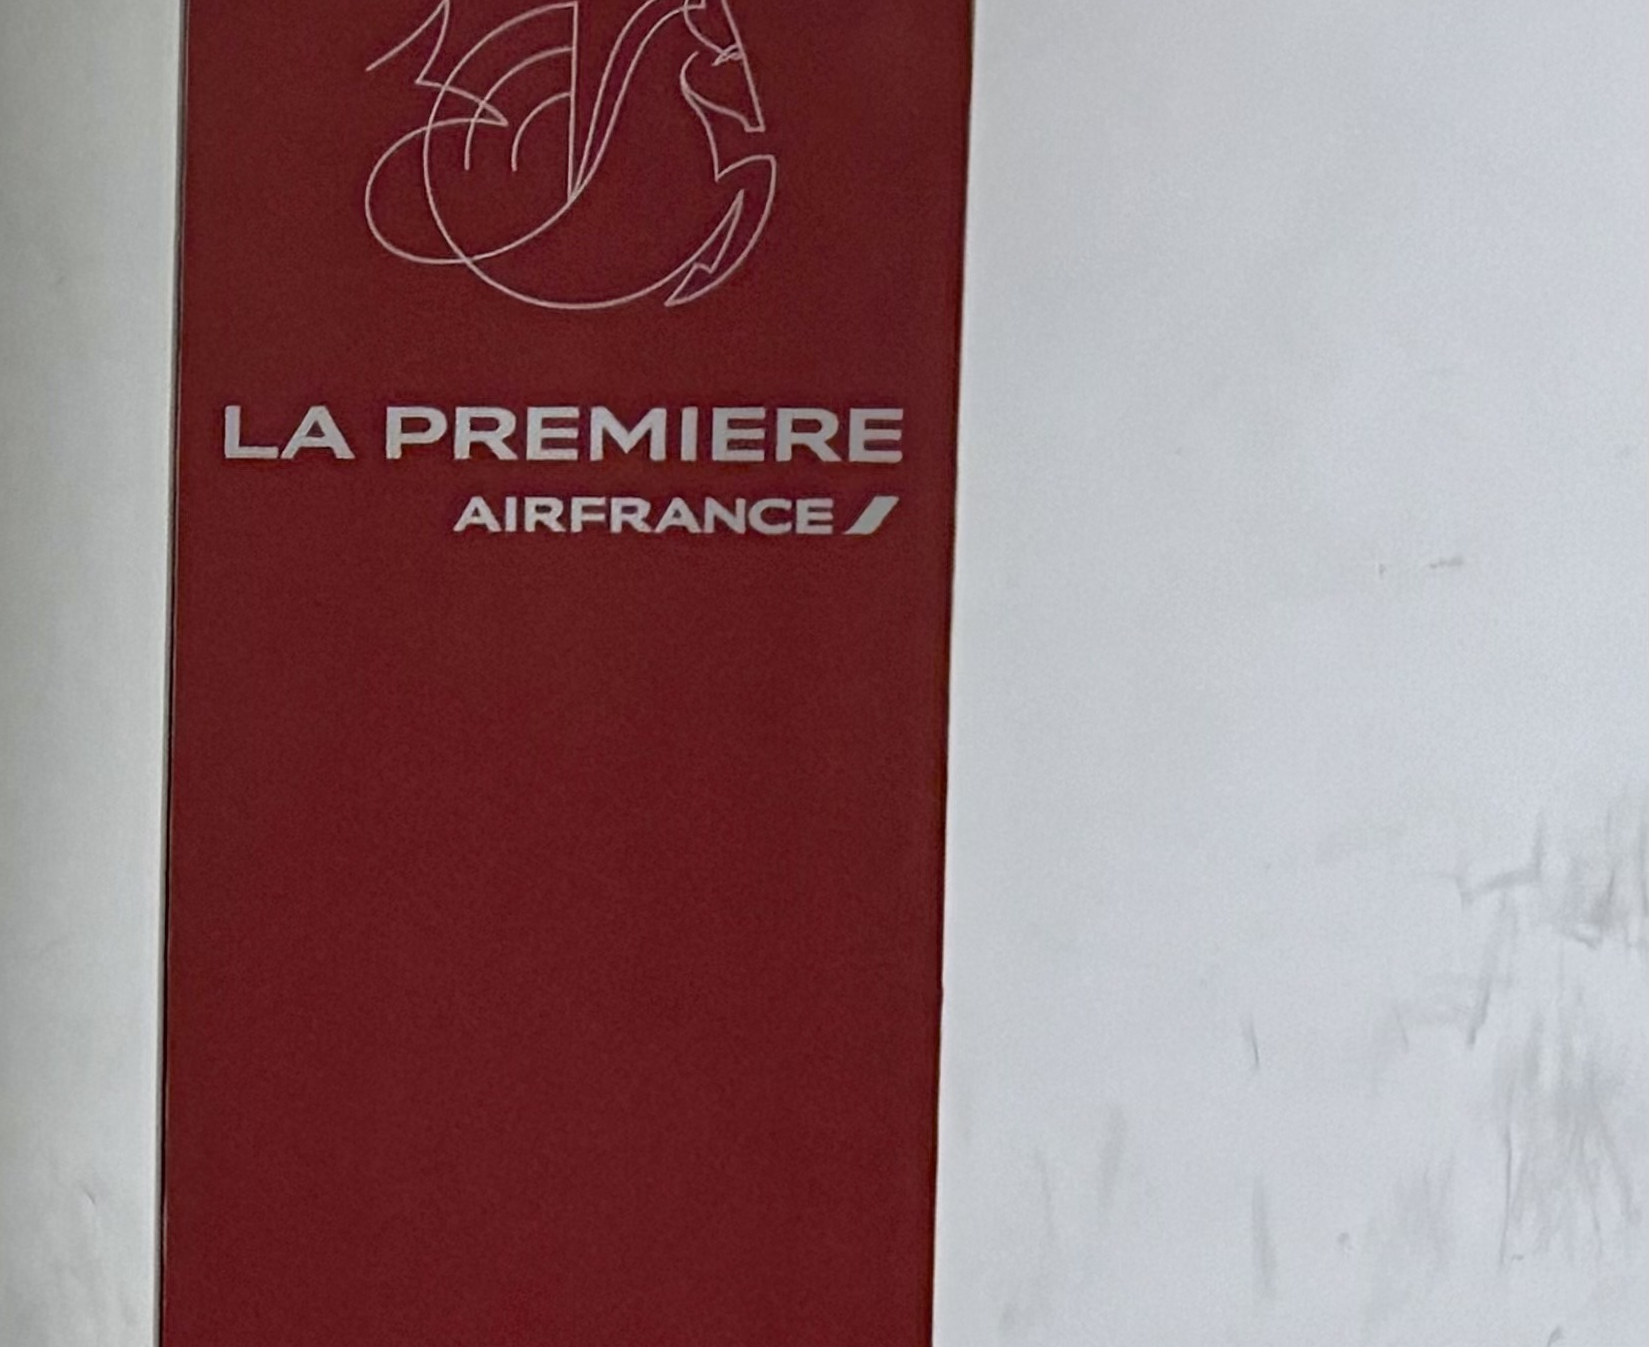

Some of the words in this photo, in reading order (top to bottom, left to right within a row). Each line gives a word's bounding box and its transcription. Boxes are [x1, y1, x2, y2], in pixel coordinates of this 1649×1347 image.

[223, 405, 355, 460] LA
[386, 407, 904, 463] PREMIERE
[453, 496, 834, 535] AIRFRANCE
